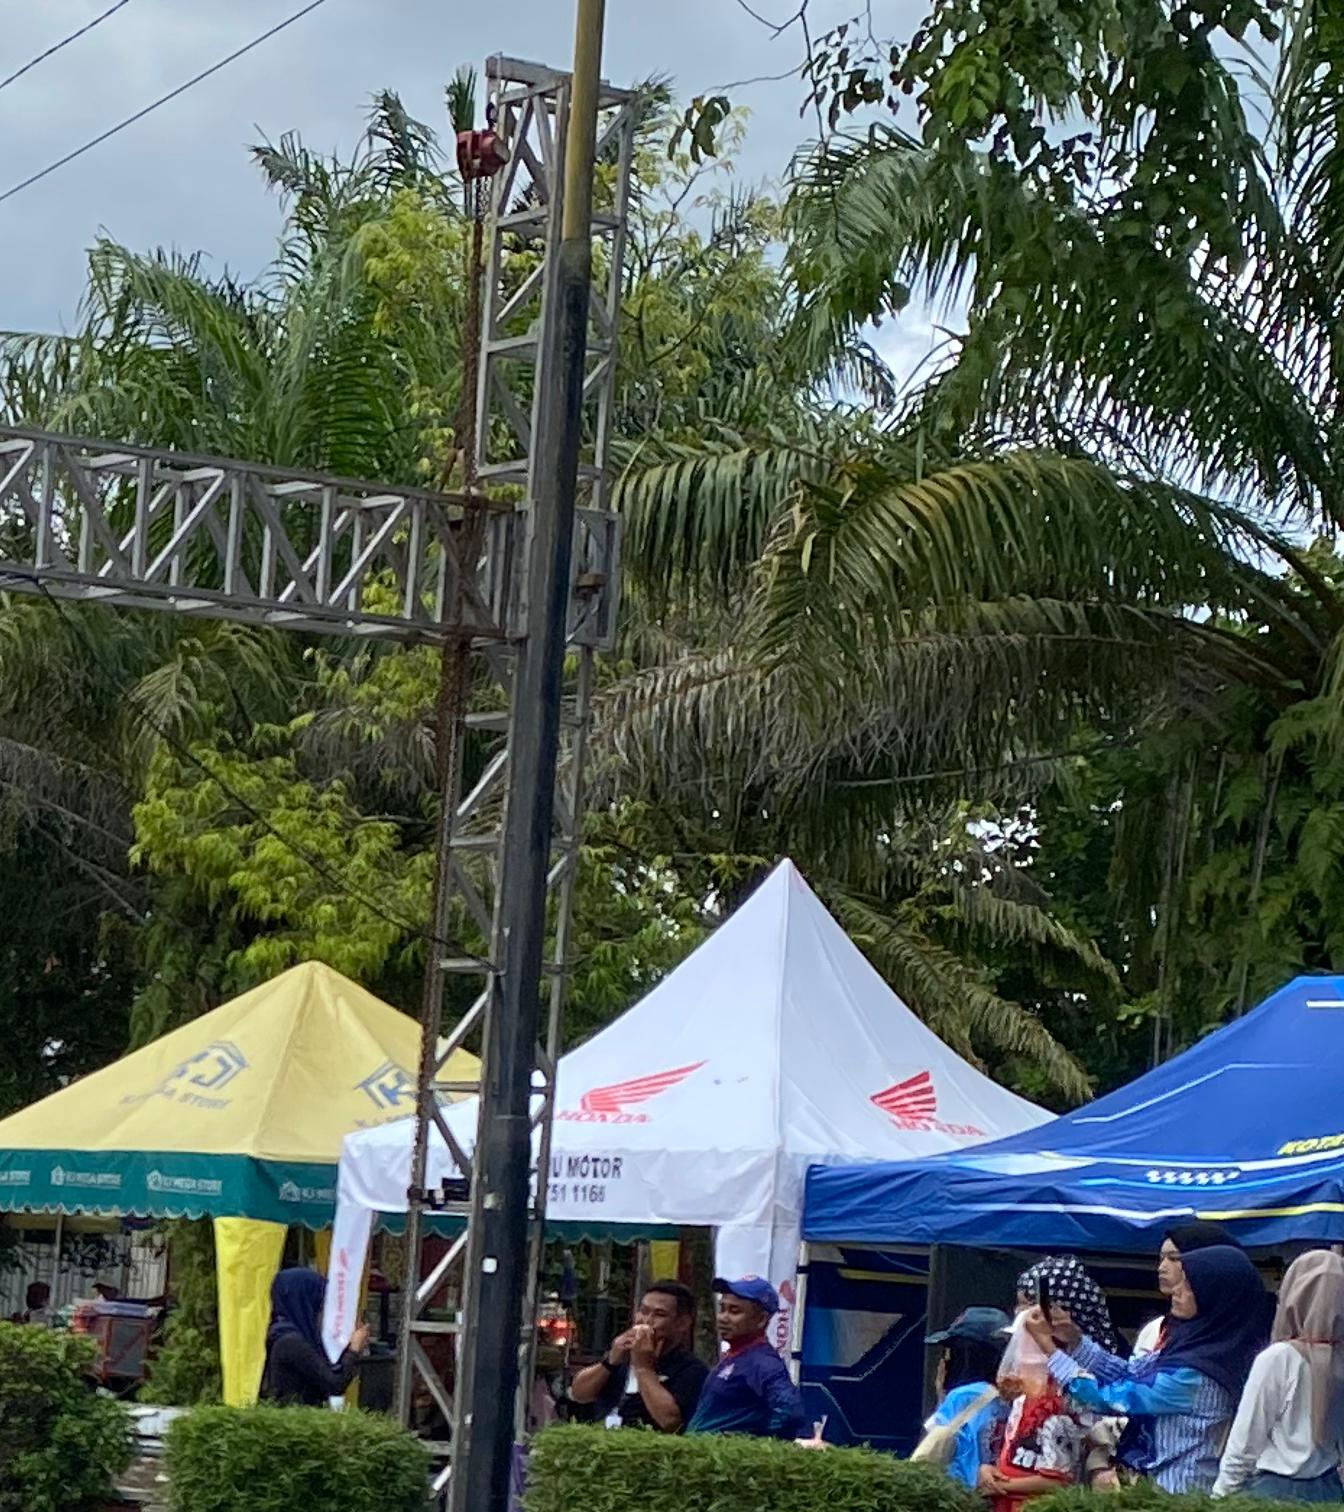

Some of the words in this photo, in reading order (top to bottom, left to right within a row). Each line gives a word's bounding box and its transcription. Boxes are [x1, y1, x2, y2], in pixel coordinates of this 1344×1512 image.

[557, 1111, 649, 1124] HONDA
[889, 1117, 987, 1136] HONDA
[567, 1156, 623, 1179] MOTOR
